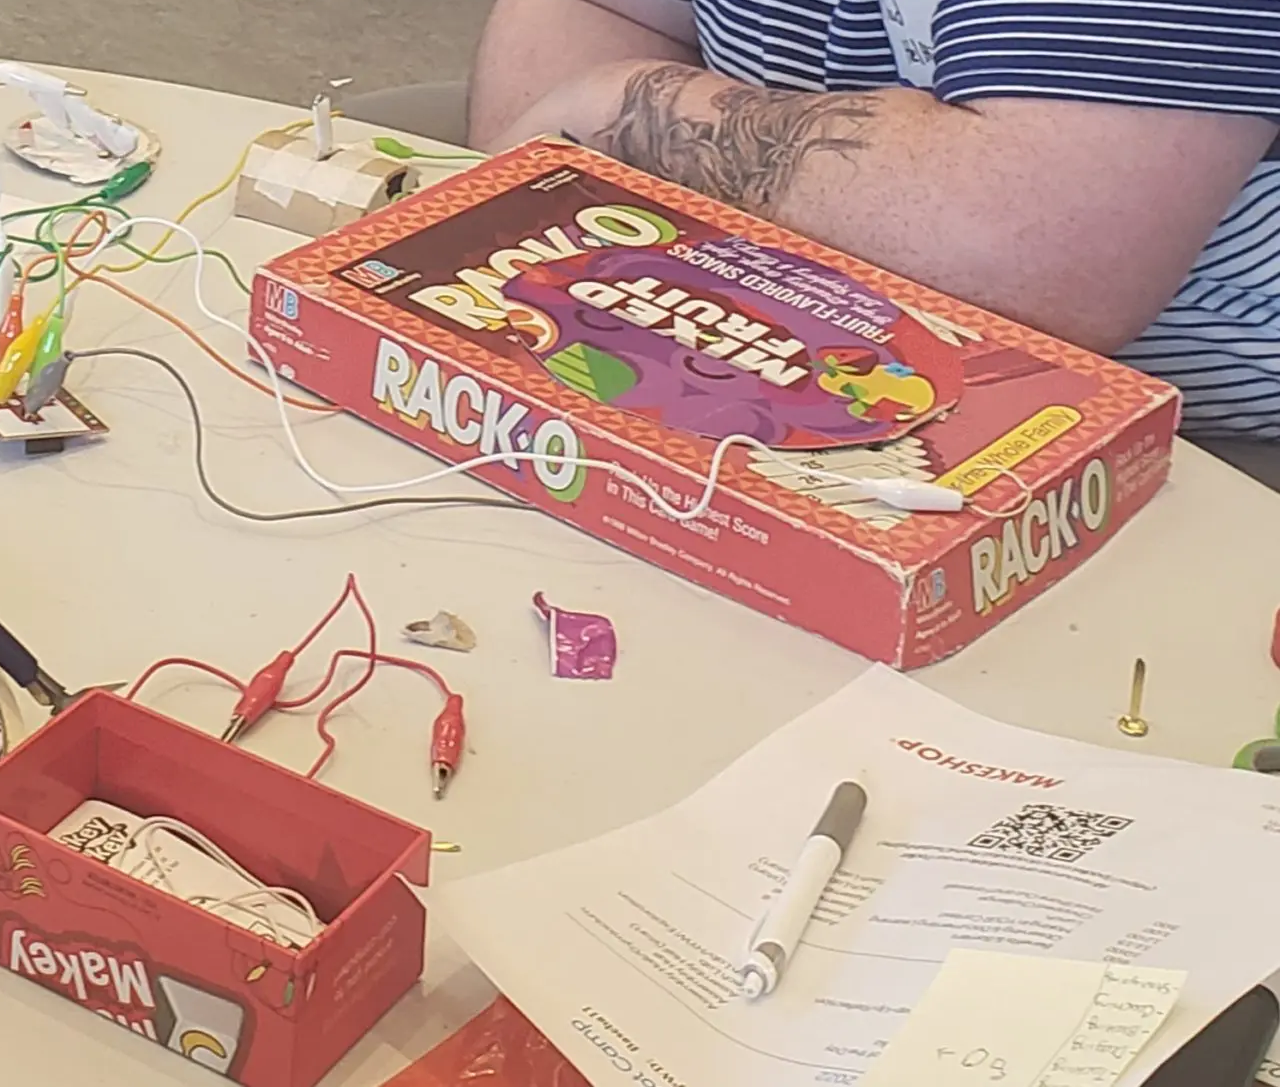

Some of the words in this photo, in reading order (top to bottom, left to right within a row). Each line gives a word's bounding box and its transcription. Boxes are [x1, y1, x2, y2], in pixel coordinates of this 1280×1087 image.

[666, 243, 745, 281] SNACKS
[568, 280, 809, 388] MIXED
[616, 275, 807, 359] FRUIT
[741, 273, 895, 345] FRUIT-FLAVORED
[606, 478, 619, 496] in
[621, 485, 648, 510] This
[732, 516, 770, 546] Score
[896, 738, 1066, 790] MAKESHOP
[10, 929, 157, 1009] Makey
[571, 1019, 633, 1073] Camp
